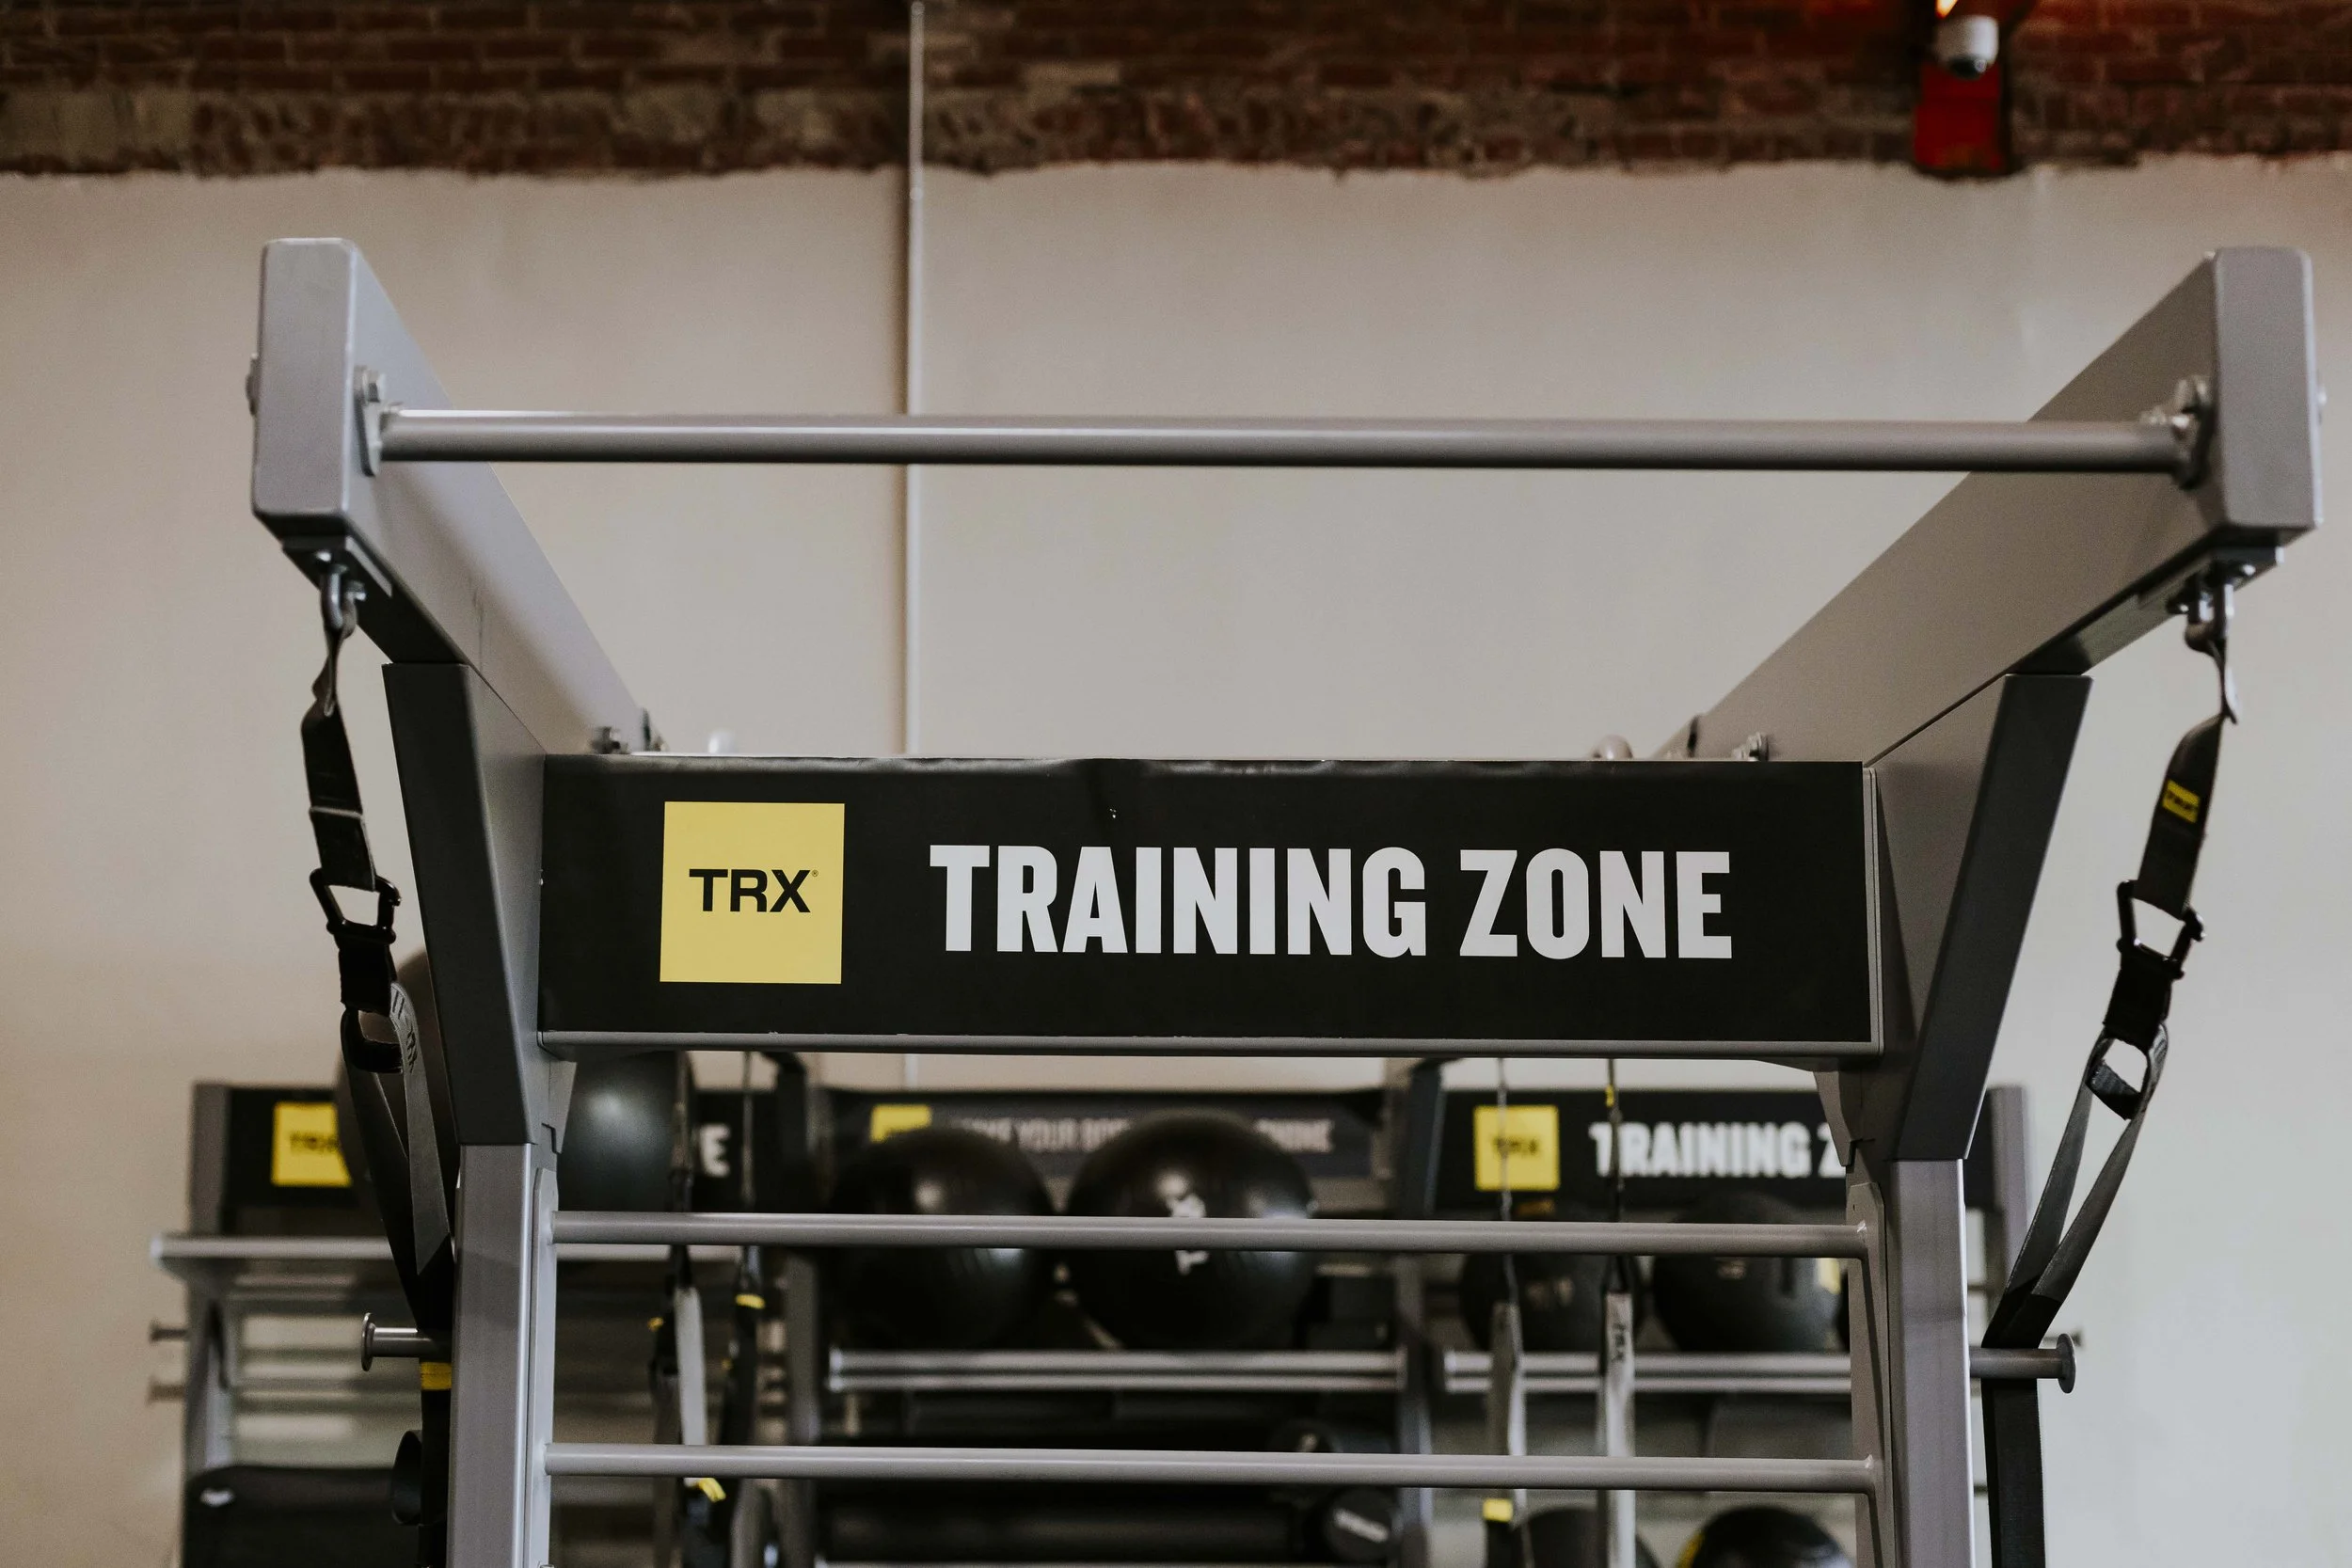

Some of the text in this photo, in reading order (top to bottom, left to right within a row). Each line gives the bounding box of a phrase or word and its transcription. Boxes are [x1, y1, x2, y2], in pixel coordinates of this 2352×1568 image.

[930, 845, 1732, 960] TRAINING ZONE
[1589, 1122, 1813, 1178] TRAINING
